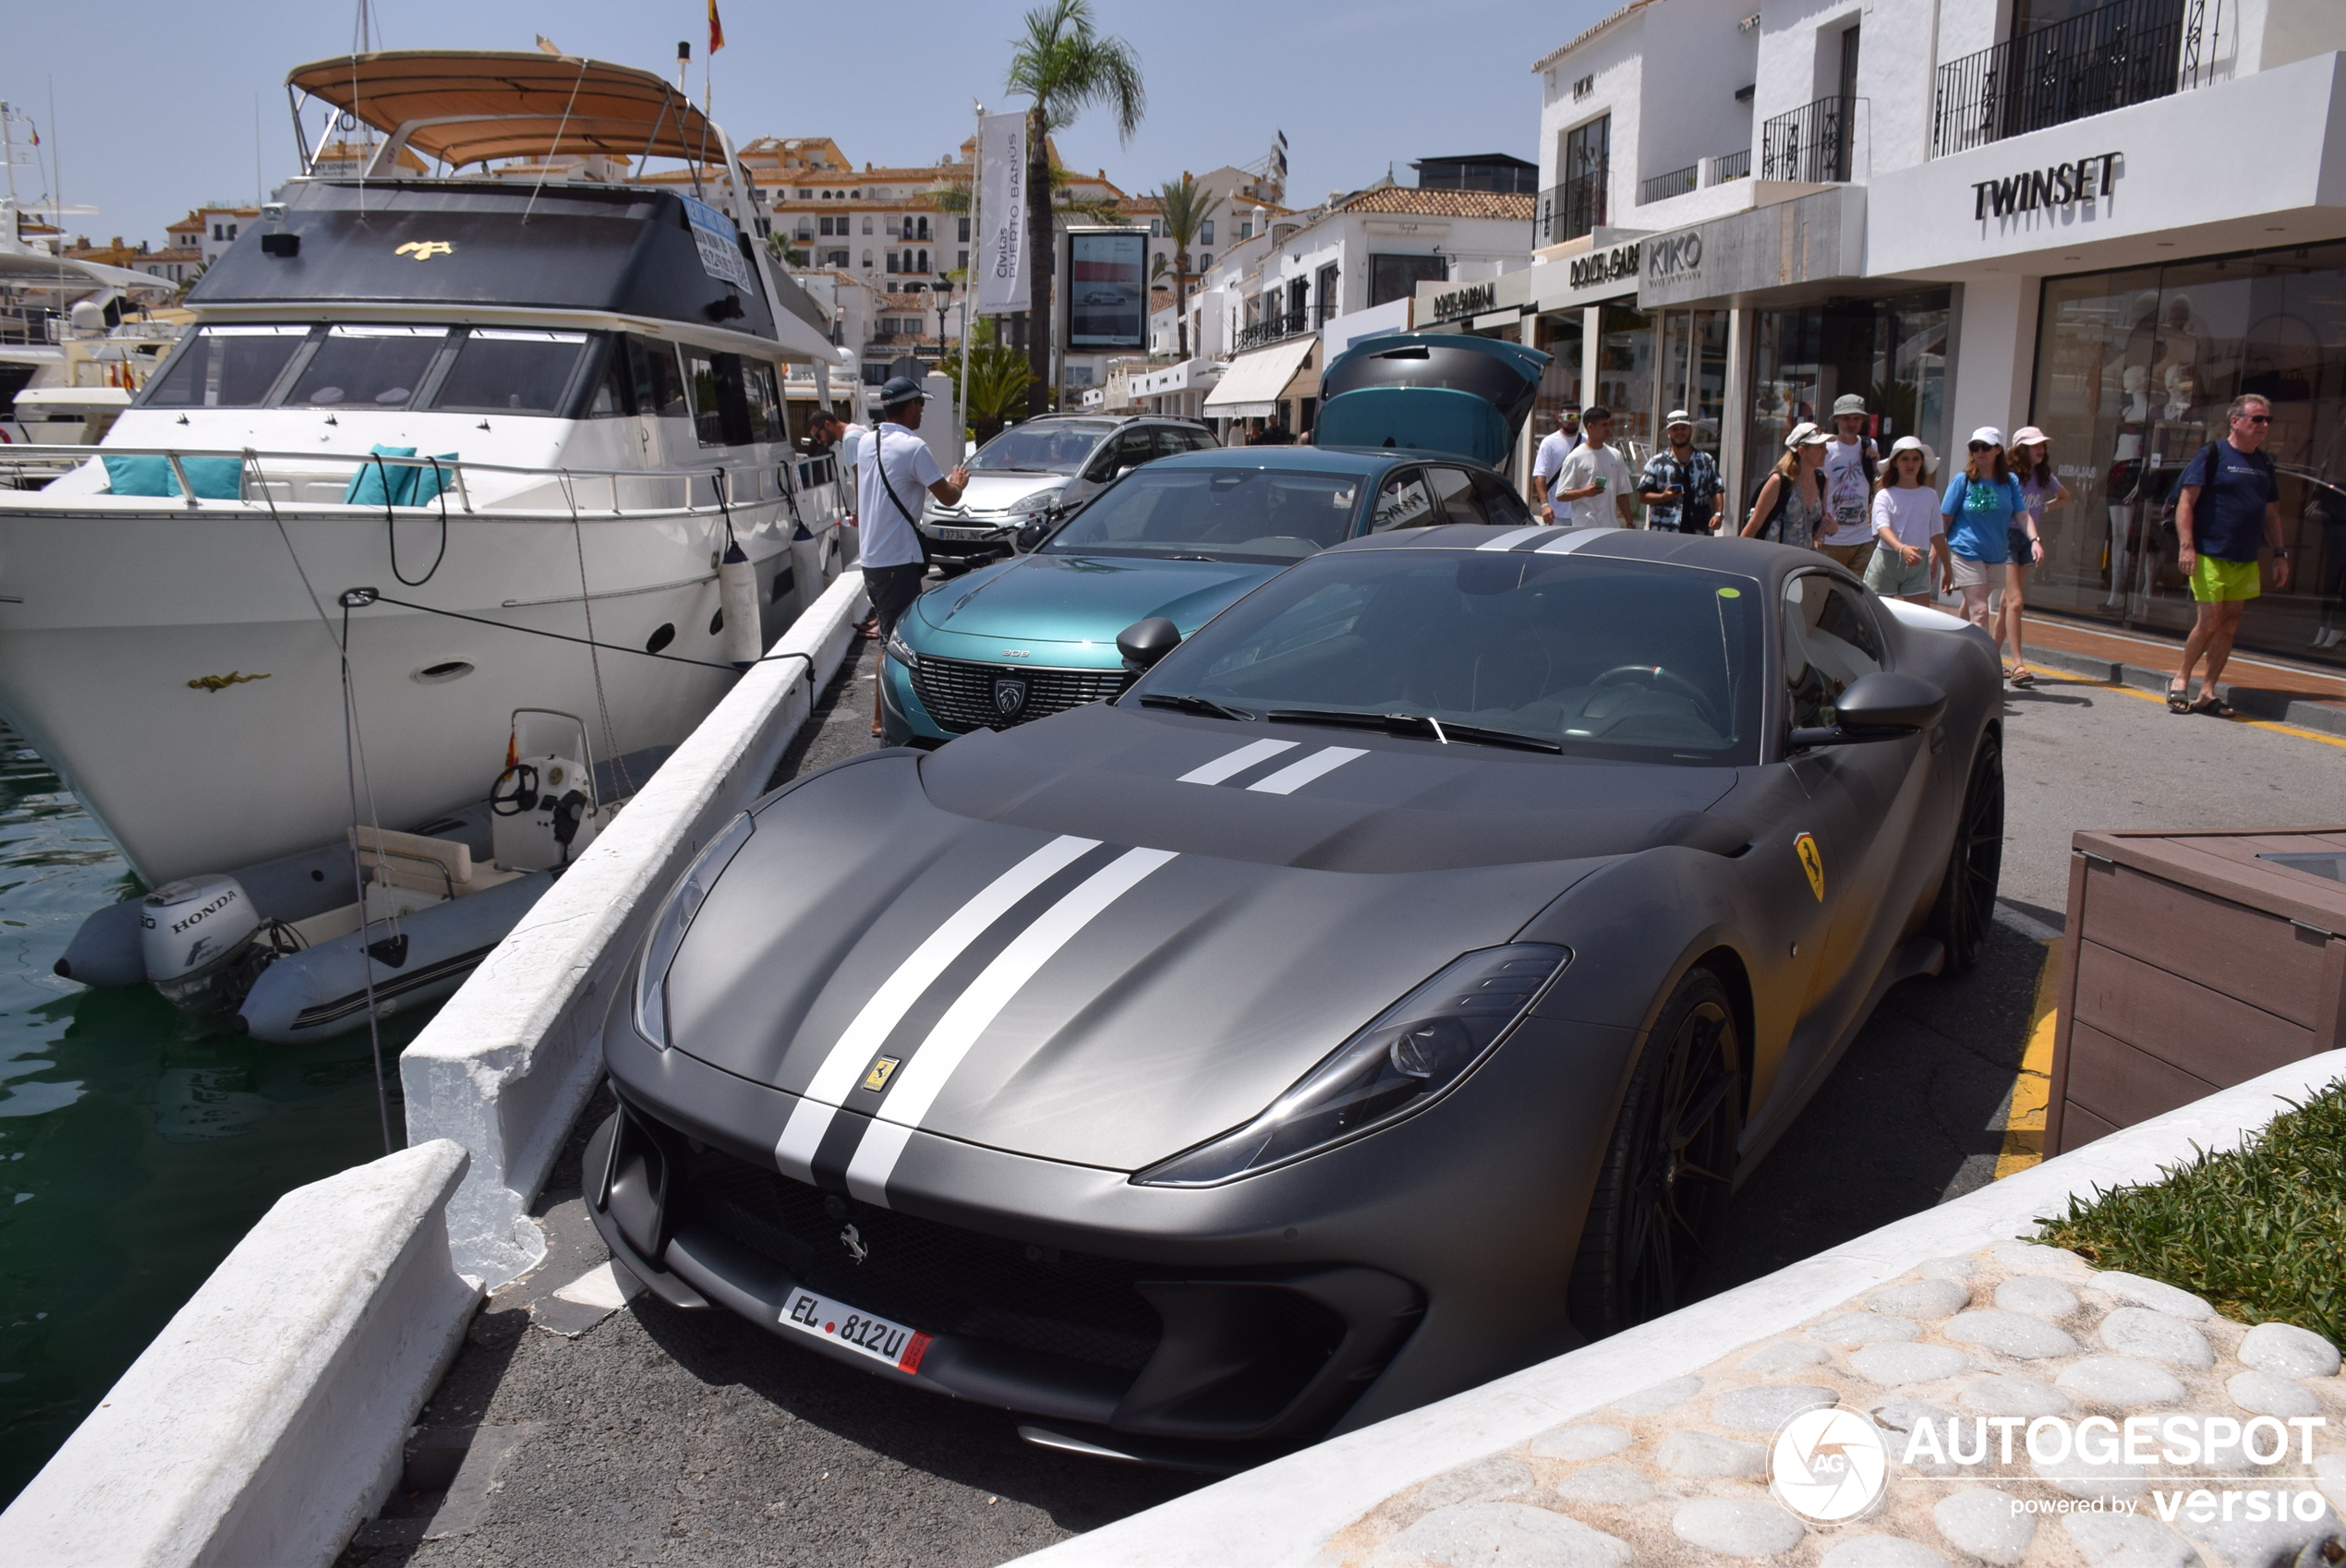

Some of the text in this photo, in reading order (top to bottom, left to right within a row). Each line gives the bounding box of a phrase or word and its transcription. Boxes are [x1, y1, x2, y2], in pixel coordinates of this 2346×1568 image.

[1573, 74, 1594, 100] DIOR
[1971, 151, 2123, 221] TWINSET
[1008, 133, 1020, 279] PUERTO BANÚS
[1650, 232, 1702, 277] KIKO
[945, 530, 964, 540] 3734
[1002, 648, 1030, 657] 308
[171, 889, 237, 935] HONDA
[790, 1295, 906, 1358] EL 812U
[910, 1345, 921, 1357] 12
[914, 1336, 925, 1347] 15
[903, 1356, 917, 1367] 23
